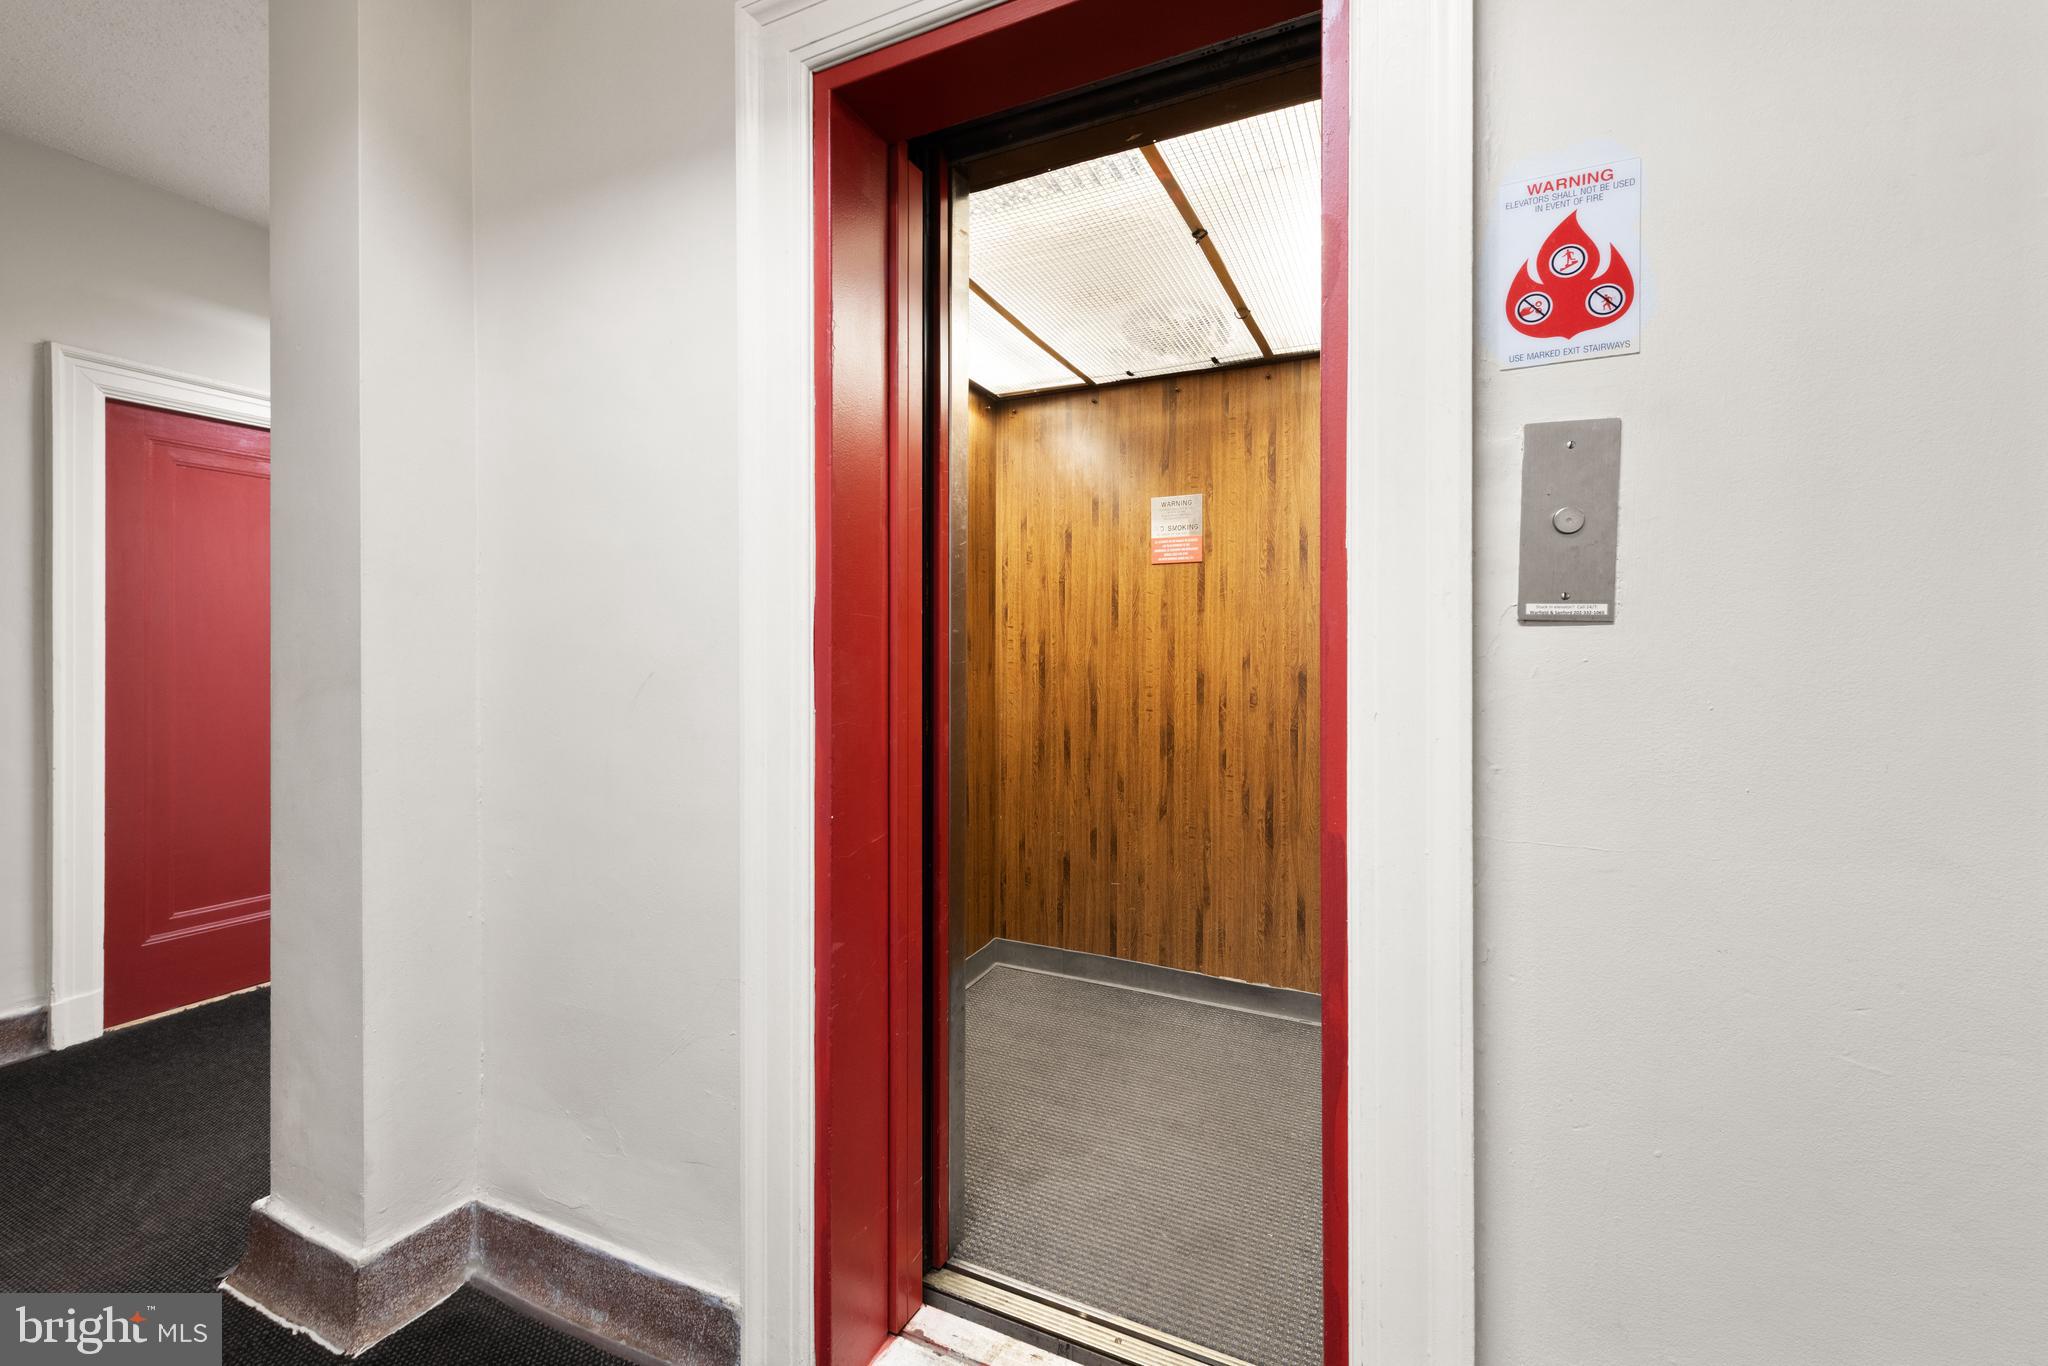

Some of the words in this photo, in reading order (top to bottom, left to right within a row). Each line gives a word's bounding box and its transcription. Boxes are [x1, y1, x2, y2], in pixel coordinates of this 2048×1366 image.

[1527, 168, 1614, 196] WARNING
[1505, 194, 1550, 210] ELEVATORS
[1551, 189, 1577, 201] SHALL
[1580, 185, 1597, 195] NOT
[1600, 182, 1610, 191] BE
[1613, 178, 1636, 190] USED
[1534, 204, 1543, 213] IN
[1545, 199, 1570, 211] EVENT
[1573, 197, 1584, 206] OF
[1586, 193, 1604, 204] FIRE
[1508, 353, 1524, 363] USE
[1526, 348, 1560, 361] MARKED
[1563, 346, 1580, 356] EXIT
[1583, 340, 1631, 353] STAIRWAYS
[1160, 500, 1192, 508] WARNING
[1167, 523, 1199, 531] SMOKING
